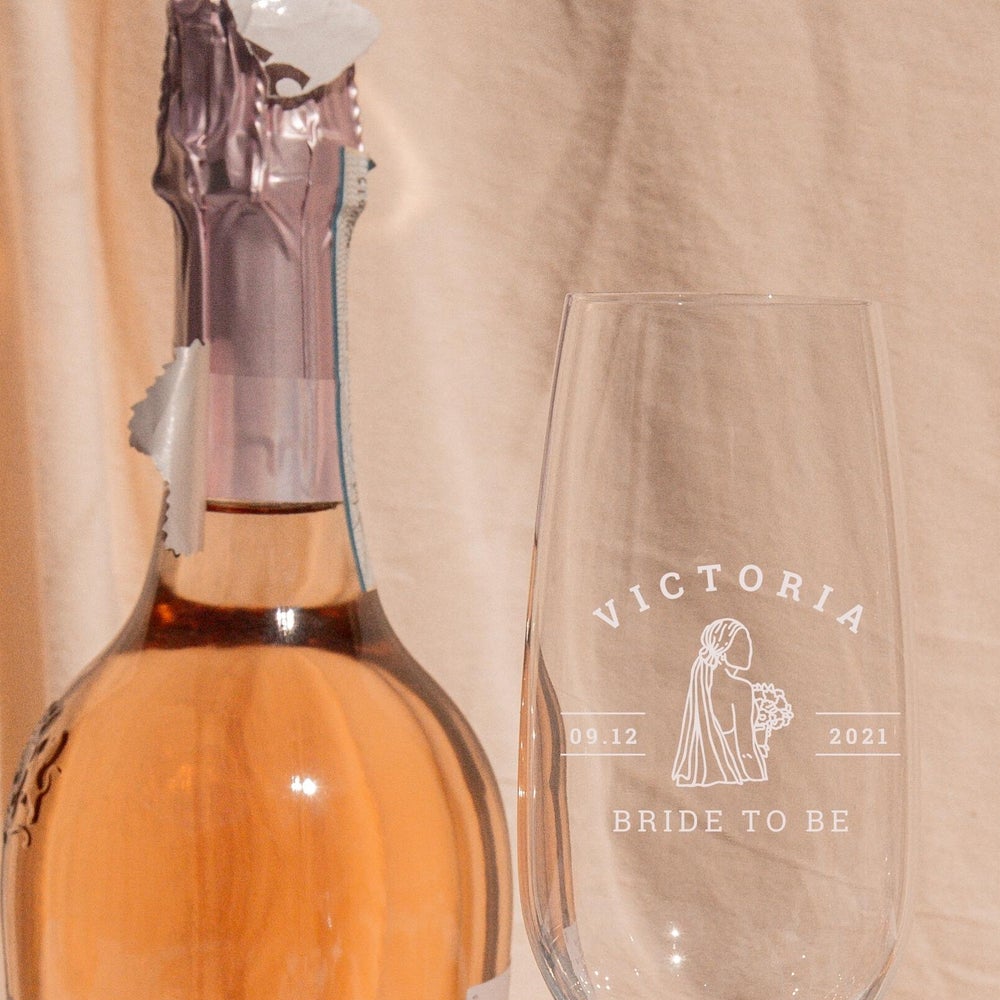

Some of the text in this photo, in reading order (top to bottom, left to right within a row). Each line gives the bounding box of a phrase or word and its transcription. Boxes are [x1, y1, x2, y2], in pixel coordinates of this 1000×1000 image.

[592, 563, 865, 634] VICTORIA
[570, 727, 638, 746] 09.12
[828, 727, 888, 745] 2021
[612, 809, 850, 833] BRIDE TO BE
